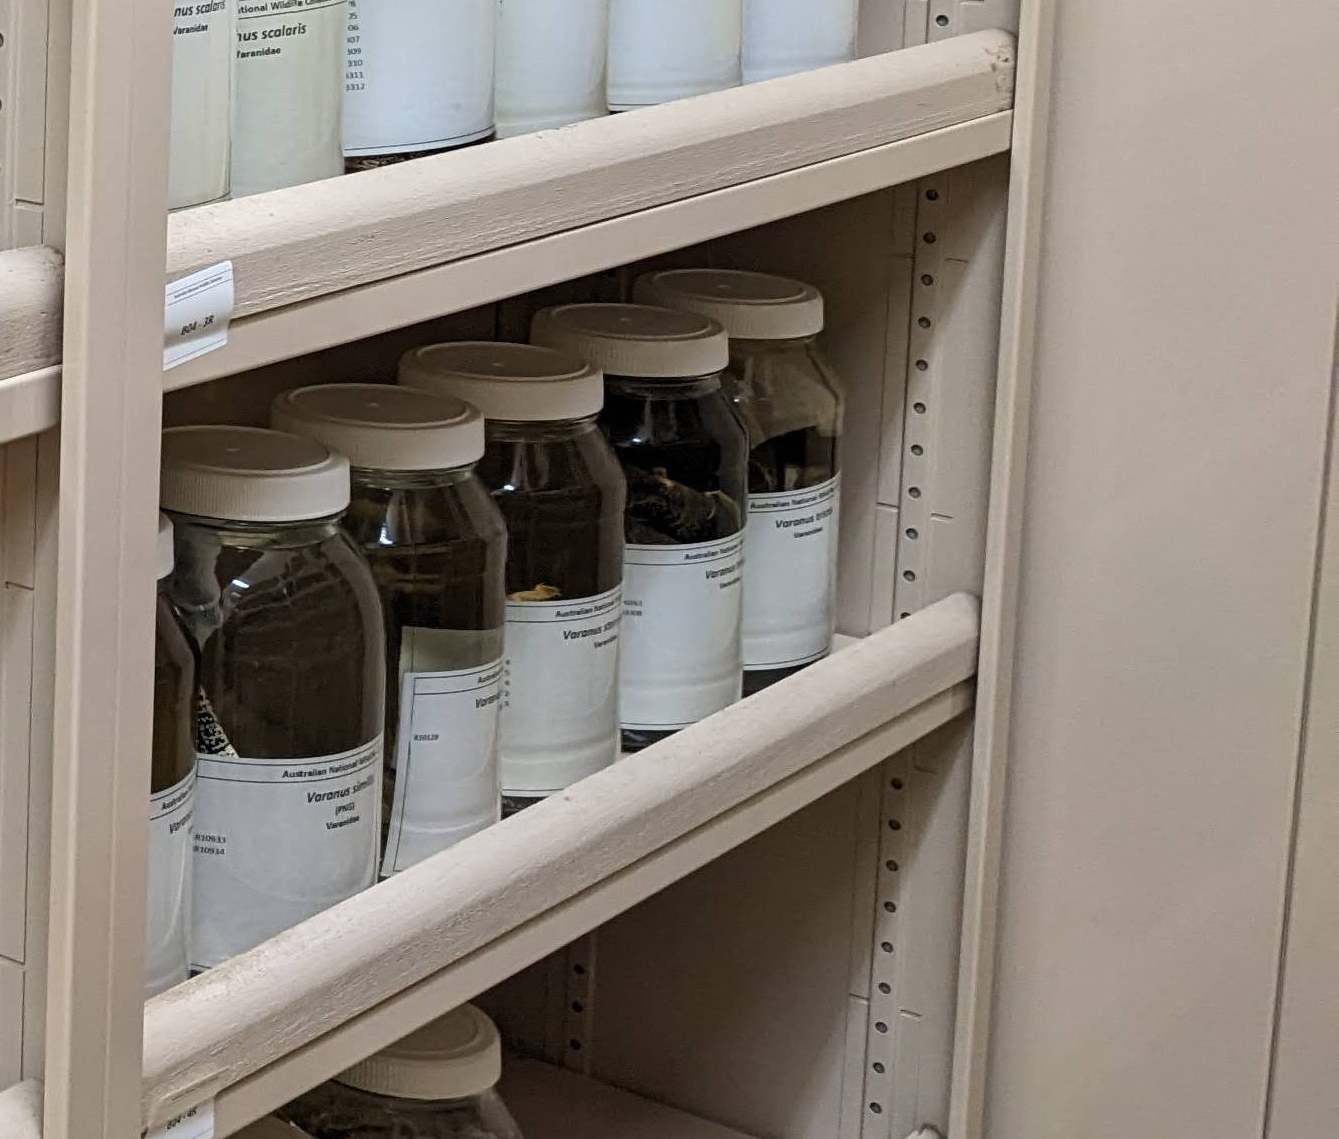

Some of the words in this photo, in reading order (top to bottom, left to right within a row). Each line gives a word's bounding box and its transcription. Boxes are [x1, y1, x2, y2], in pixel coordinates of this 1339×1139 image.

[271, 0, 302, 11] Wildlife
[262, 23, 306, 39] scalaris
[776, 518, 813, 528] Varanus
[563, 627, 602, 640] Varanus
[282, 767, 327, 779] Australian
[307, 786, 351, 804] Varanus
